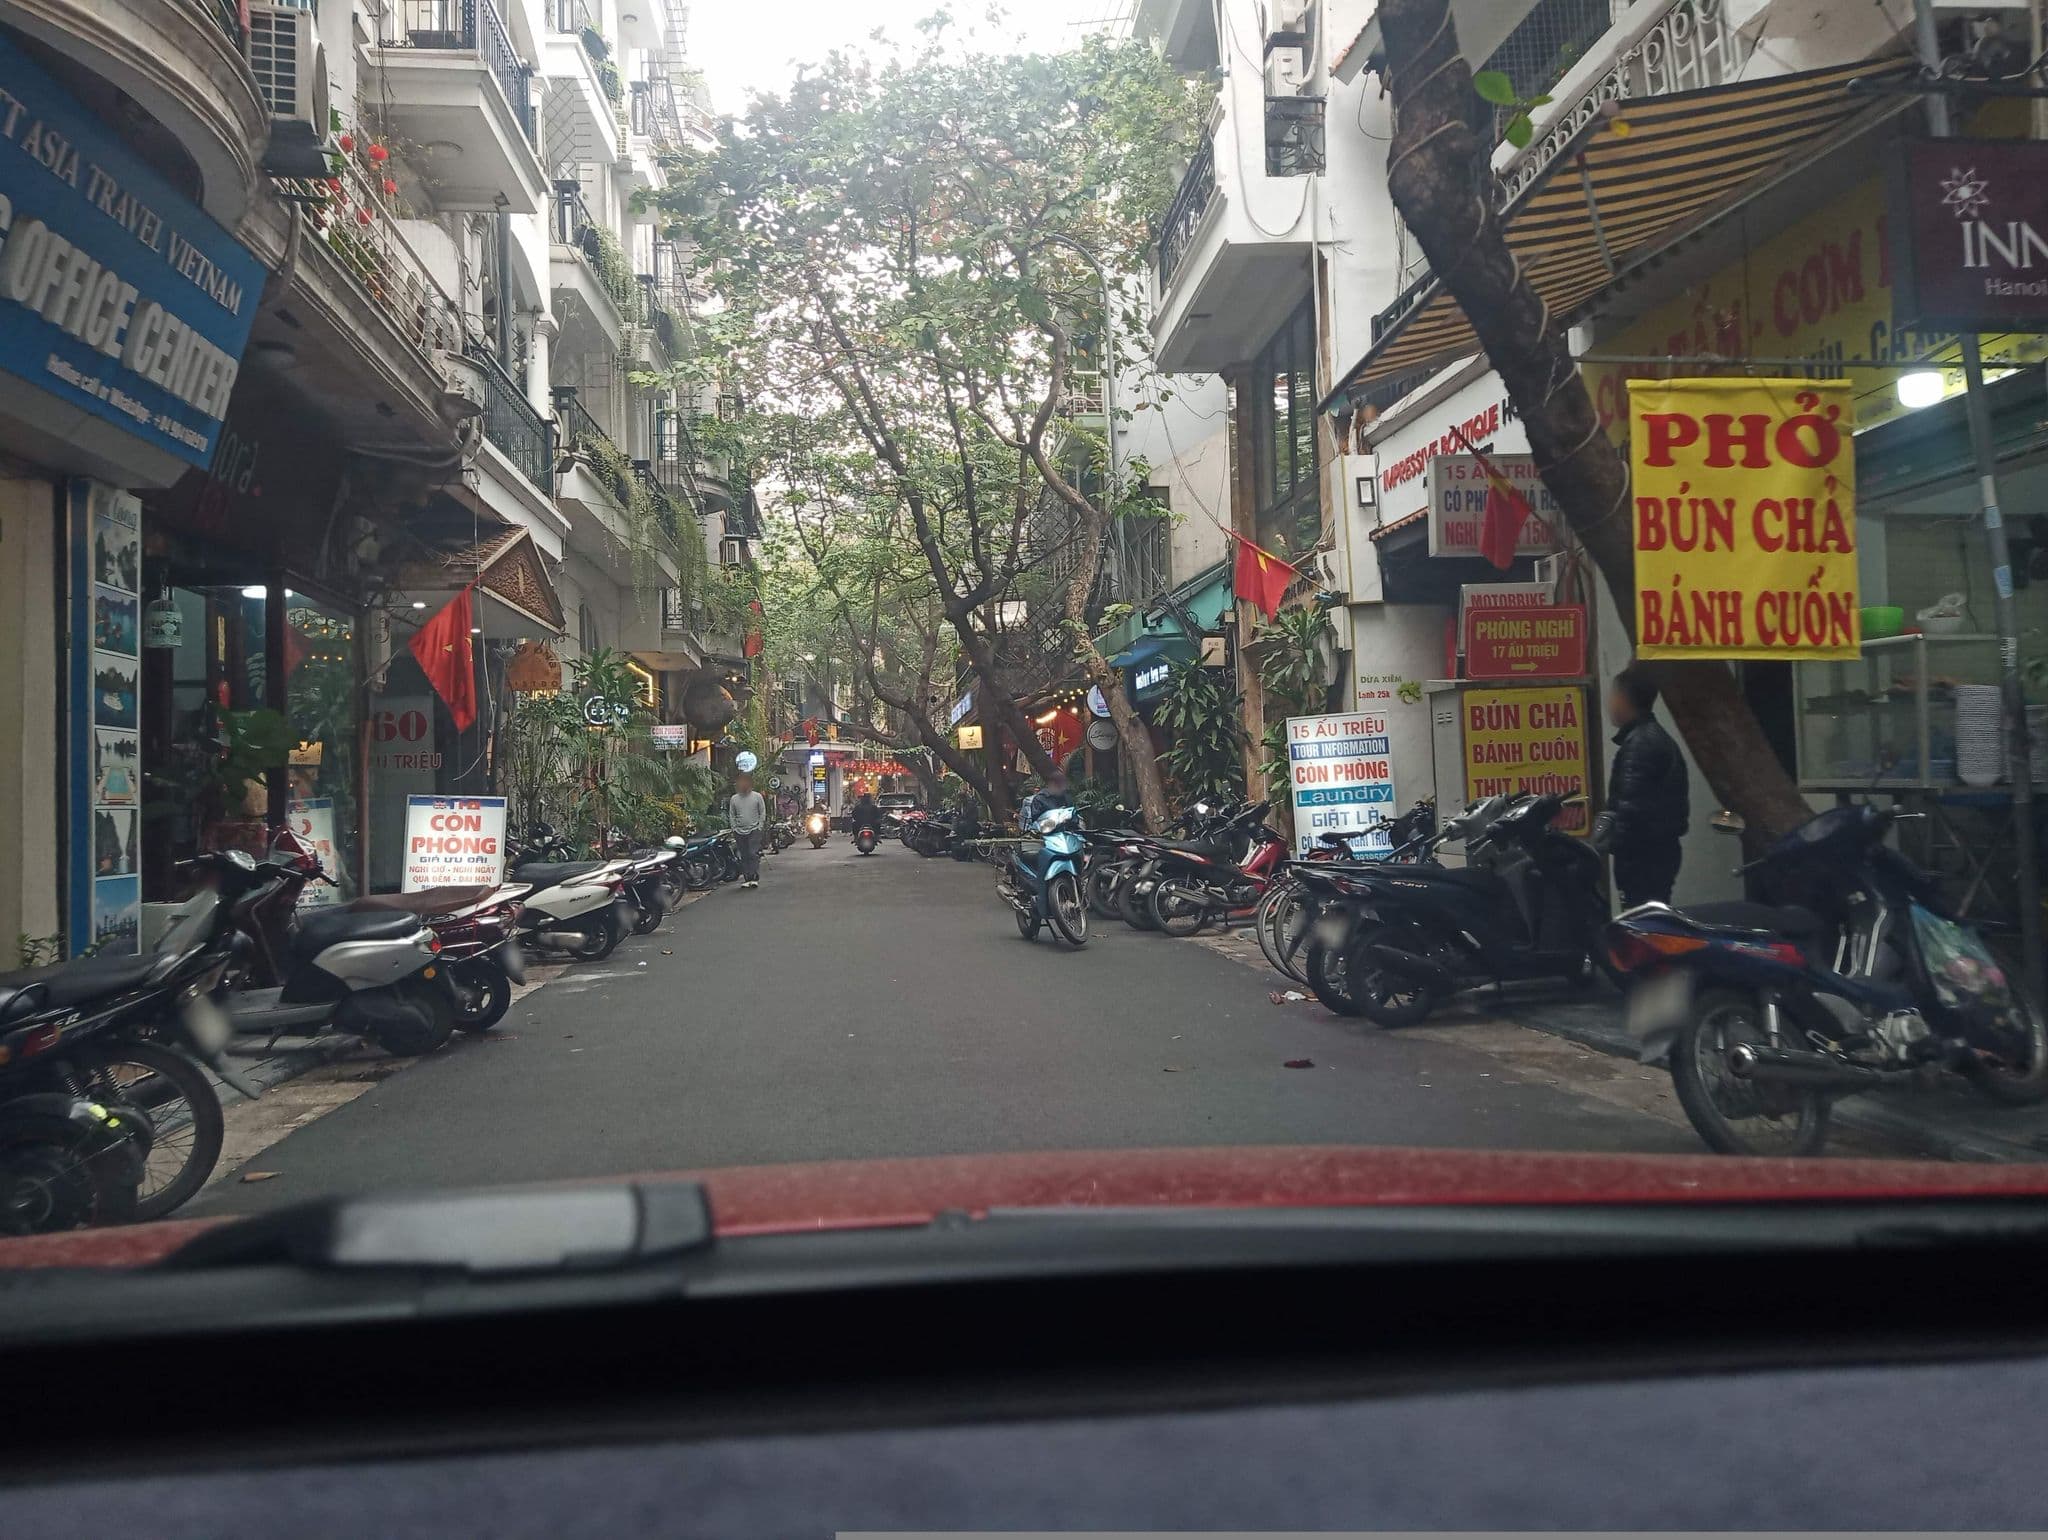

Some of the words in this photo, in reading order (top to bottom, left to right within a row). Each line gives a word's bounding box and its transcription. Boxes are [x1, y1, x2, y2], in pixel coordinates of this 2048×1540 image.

[20, 119, 80, 188] ASIA
[86, 163, 163, 254] TRAVEL
[166, 230, 243, 316] VIETNAM
[1960, 220, 2048, 269] INN
[7, 217, 138, 359] OFFICE
[127, 299, 240, 422] CENTER
[1640, 391, 1841, 469] PHỞ
[1382, 439, 1438, 493] IMPRESSIVE
[1440, 403, 1499, 456] BOUTIQUE
[1447, 465, 1466, 480] 15
[1444, 485, 1461, 512] CÓ
[1636, 480, 1736, 552] BÚN
[1752, 475, 1854, 553] CHẢ
[1470, 592, 1547, 607] MOTORBIKE
[1641, 573, 1745, 646] BÁNH
[1756, 565, 1854, 646] CUỐN
[1476, 616, 1531, 640] PHÒNG
[1535, 614, 1575, 638] NGHỈ
[1492, 645, 1506, 658] 17
[1526, 643, 1559, 660] TRIỆU
[1470, 699, 1521, 731] BÚN
[1528, 694, 1578, 730] CHẢ
[1292, 724, 1310, 739] 15
[1315, 718, 1338, 737] ẤU
[1342, 717, 1385, 737] TRIỆU
[394, 751, 442, 772] TRIỆU
[1294, 745, 1319, 758] TOUR
[1321, 739, 1386, 756] INFORMATION
[1472, 739, 1523, 764] BÁNH
[1529, 733, 1579, 761] CUỐN
[1295, 761, 1329, 784] CÒN
[1333, 758, 1389, 782] PHÒNG
[1298, 786, 1391, 804] Laundry
[430, 811, 482, 832] CÒN
[1356, 806, 1380, 826] LÀ
[411, 834, 497, 854] PHÒNG
